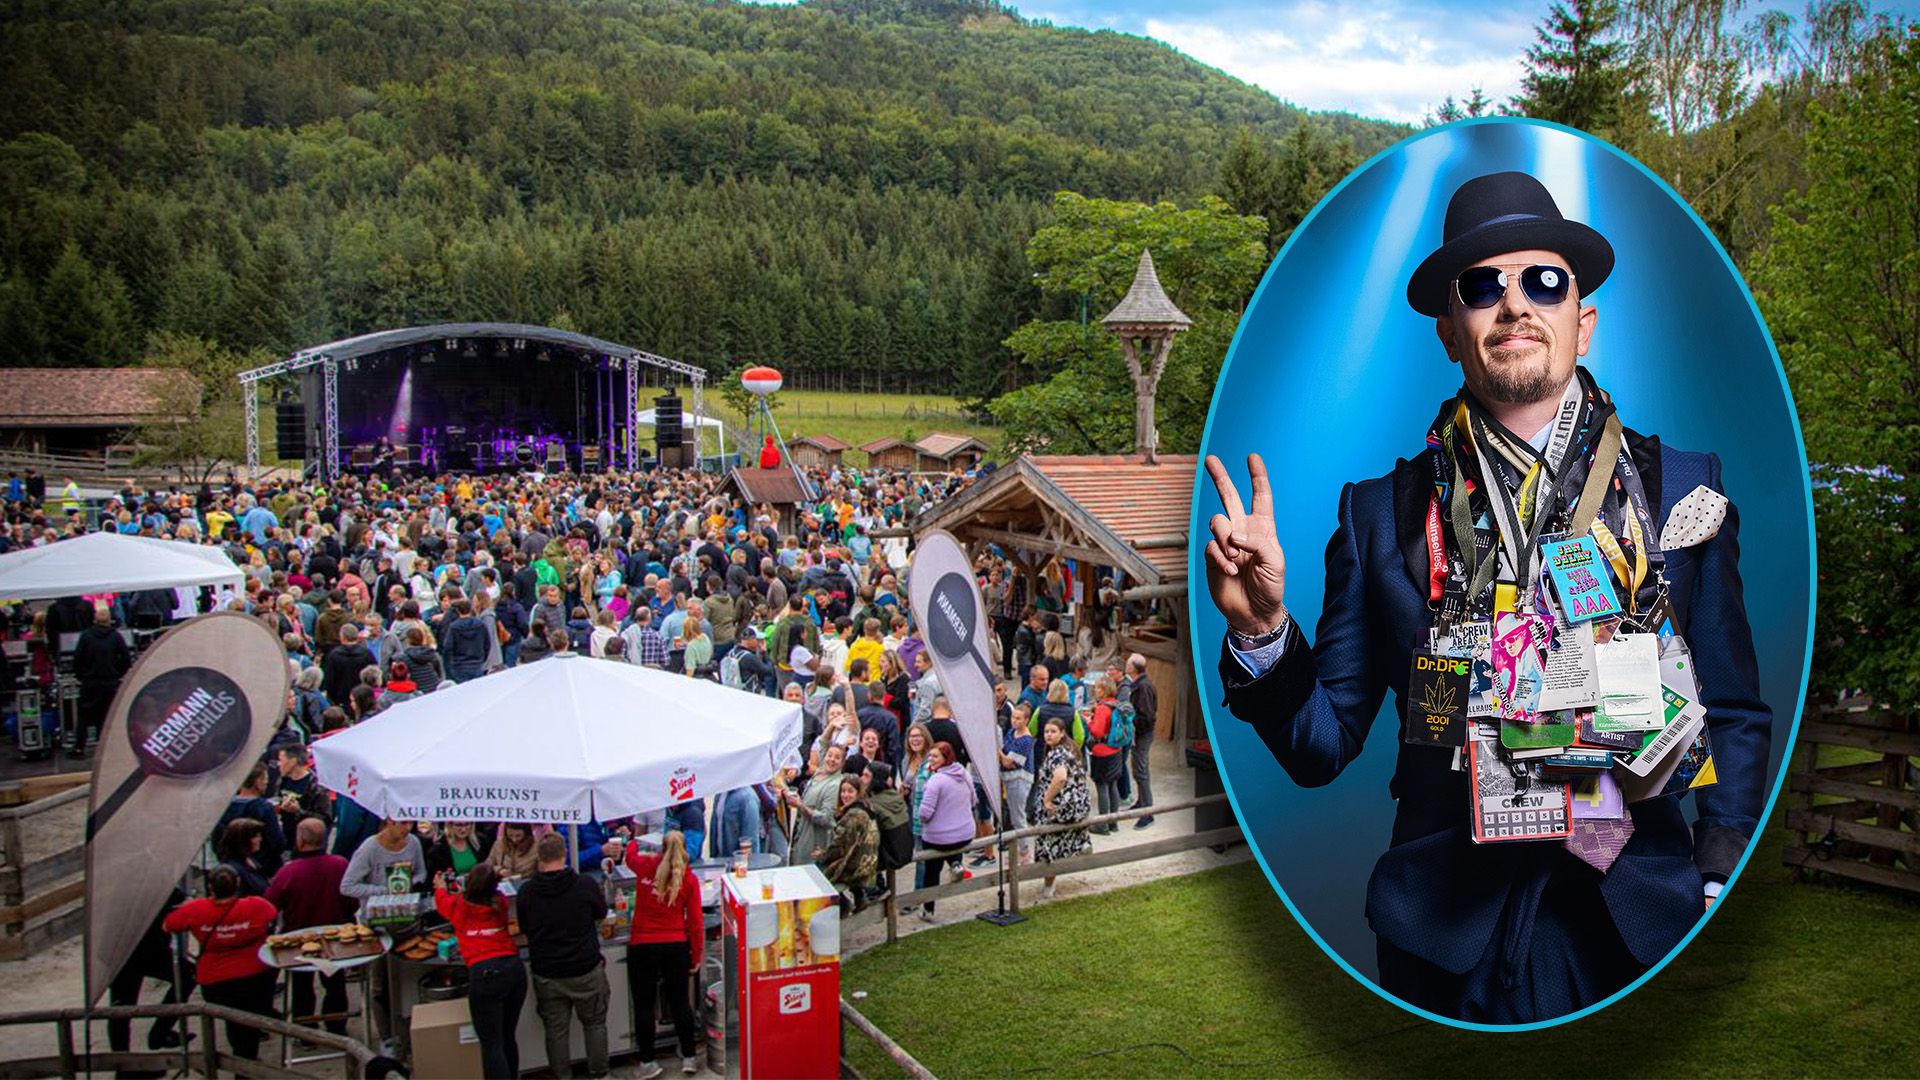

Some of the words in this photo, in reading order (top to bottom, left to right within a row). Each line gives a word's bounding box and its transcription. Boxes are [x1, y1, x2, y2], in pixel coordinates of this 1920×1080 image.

[1558, 542, 1582, 555] JAN
[1553, 550, 1593, 566] DELAY
[1573, 593, 1614, 617] AAA
[1463, 624, 1488, 639] CREW
[1452, 636, 1479, 647] AREAS
[142, 687, 213, 757] HERMANN
[158, 690, 236, 768] FLEISCHLOS
[1601, 732, 1625, 742] ARTIST
[670, 773, 696, 797] Stiegl
[440, 787, 541, 802] BRAUKUNST
[1501, 796, 1544, 808] CREW
[397, 806, 429, 818] AUF
[435, 803, 527, 819] HÖCHSTER
[531, 807, 582, 821] STUFE
